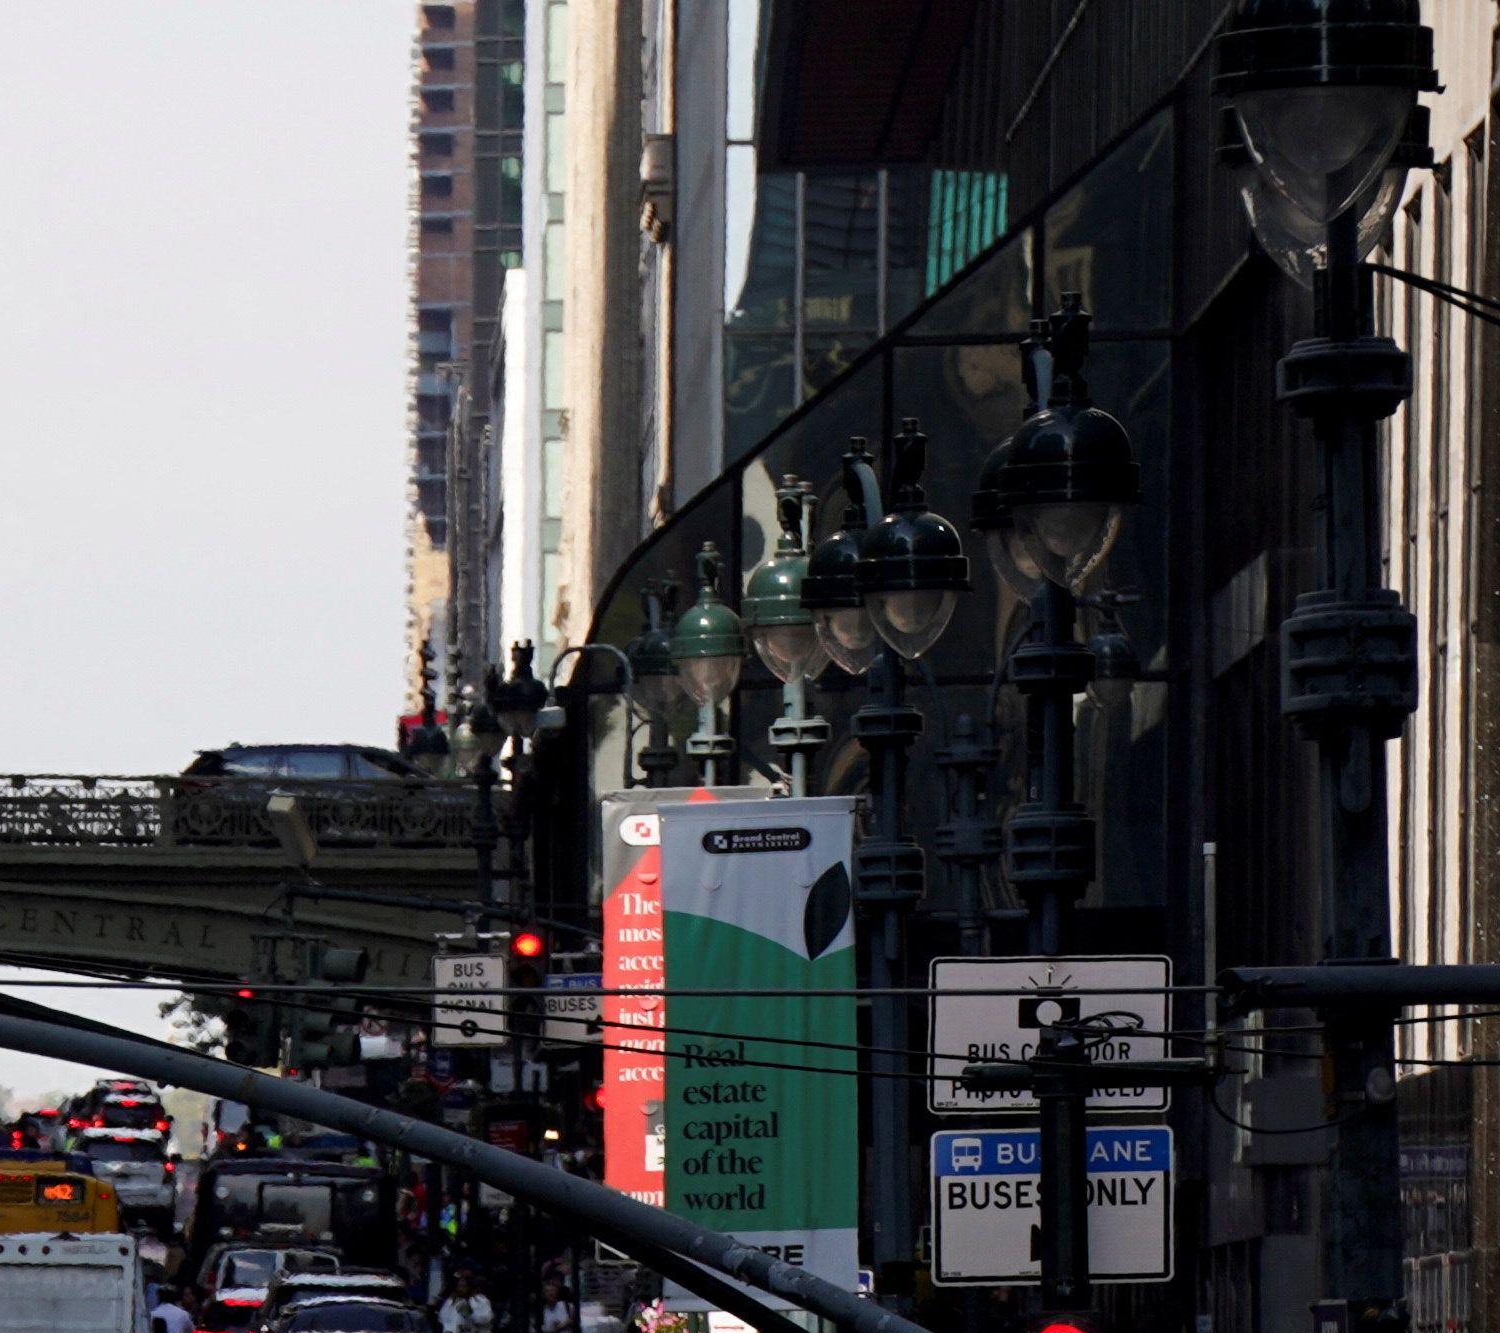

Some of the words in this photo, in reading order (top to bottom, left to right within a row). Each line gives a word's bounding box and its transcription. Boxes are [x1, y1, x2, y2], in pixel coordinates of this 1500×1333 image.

[732, 831, 760, 842] Grand
[764, 830, 800, 841] Central
[618, 893, 660, 916] The
[618, 926, 662, 943] mos
[453, 962, 485, 978] BUS
[547, 997, 597, 1013] BUSES
[683, 1041, 745, 1069] Real
[967, 1043, 1011, 1062] BUS
[682, 1082, 767, 1105] estate
[682, 1112, 779, 1146] capital
[682, 1147, 714, 1175] of
[716, 1148, 763, 1175] the
[996, 1143, 1043, 1165] BU
[1090, 1139, 1152, 1162] ANE
[683, 1184, 765, 1211] world
